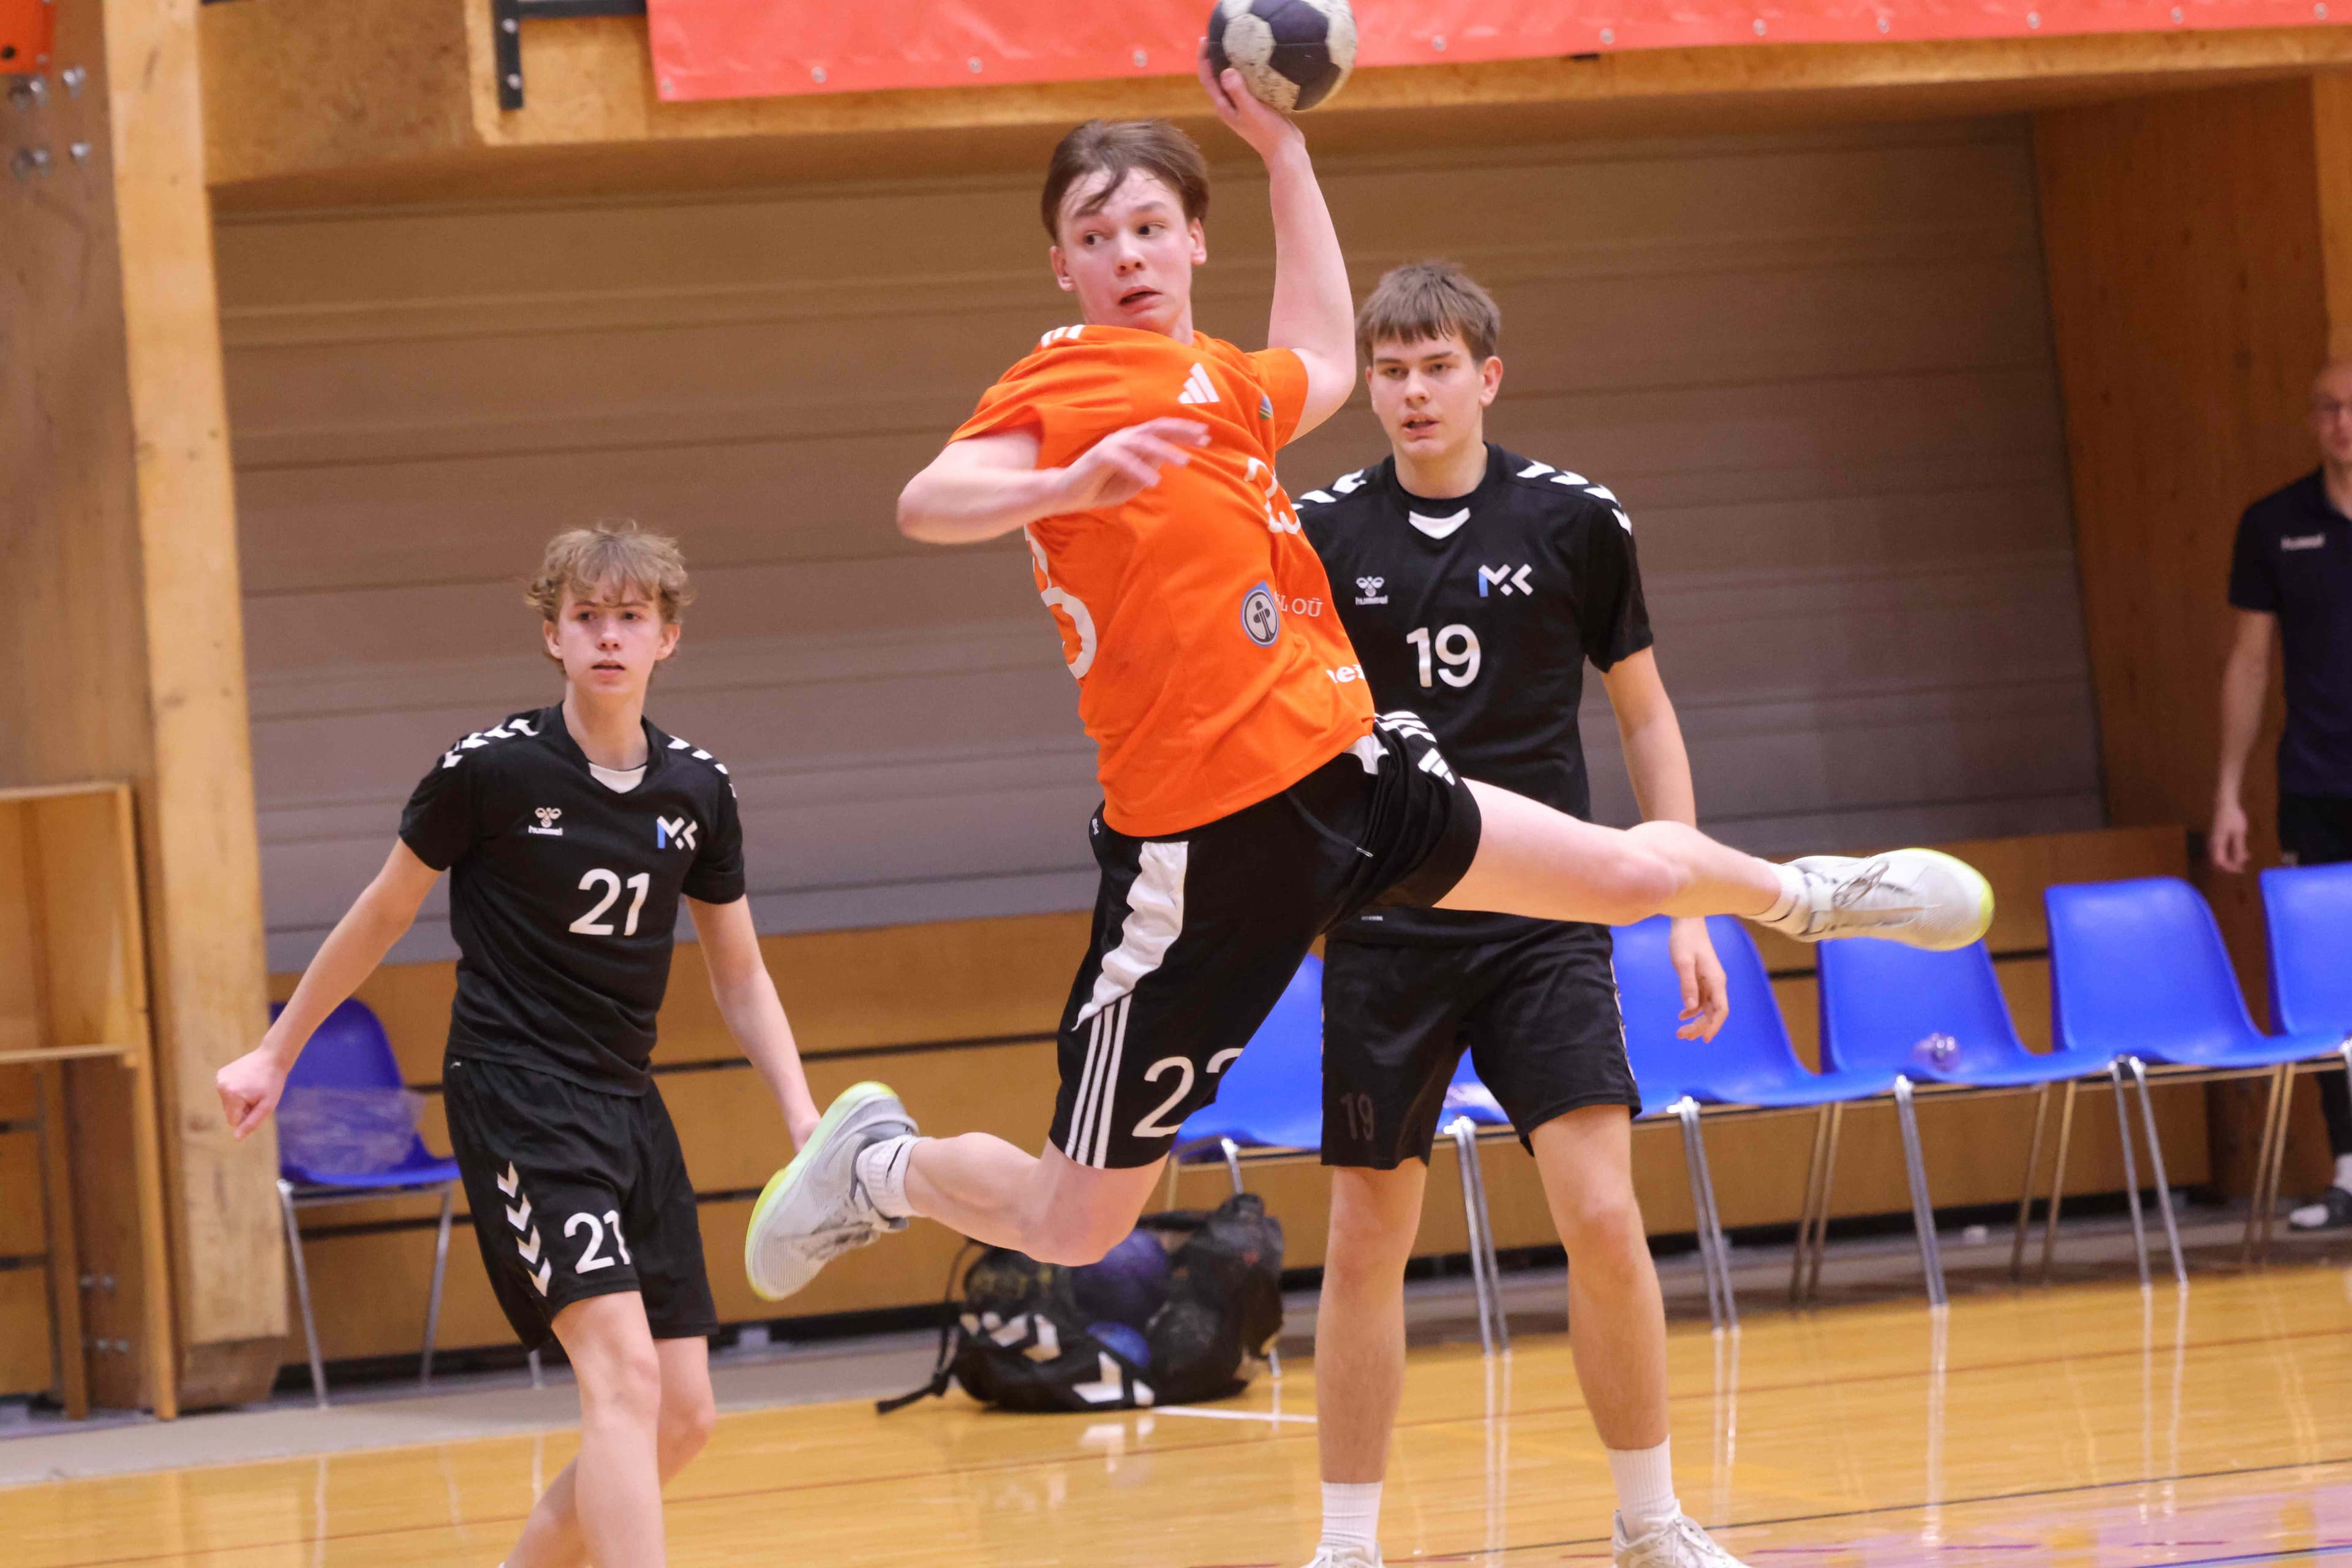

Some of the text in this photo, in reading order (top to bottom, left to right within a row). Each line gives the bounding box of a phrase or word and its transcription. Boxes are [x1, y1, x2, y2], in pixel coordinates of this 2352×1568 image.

[1406, 624, 1482, 688] 19
[569, 868, 650, 936] 21
[1339, 1093, 1375, 1142] 19
[564, 1210, 630, 1274] 21
